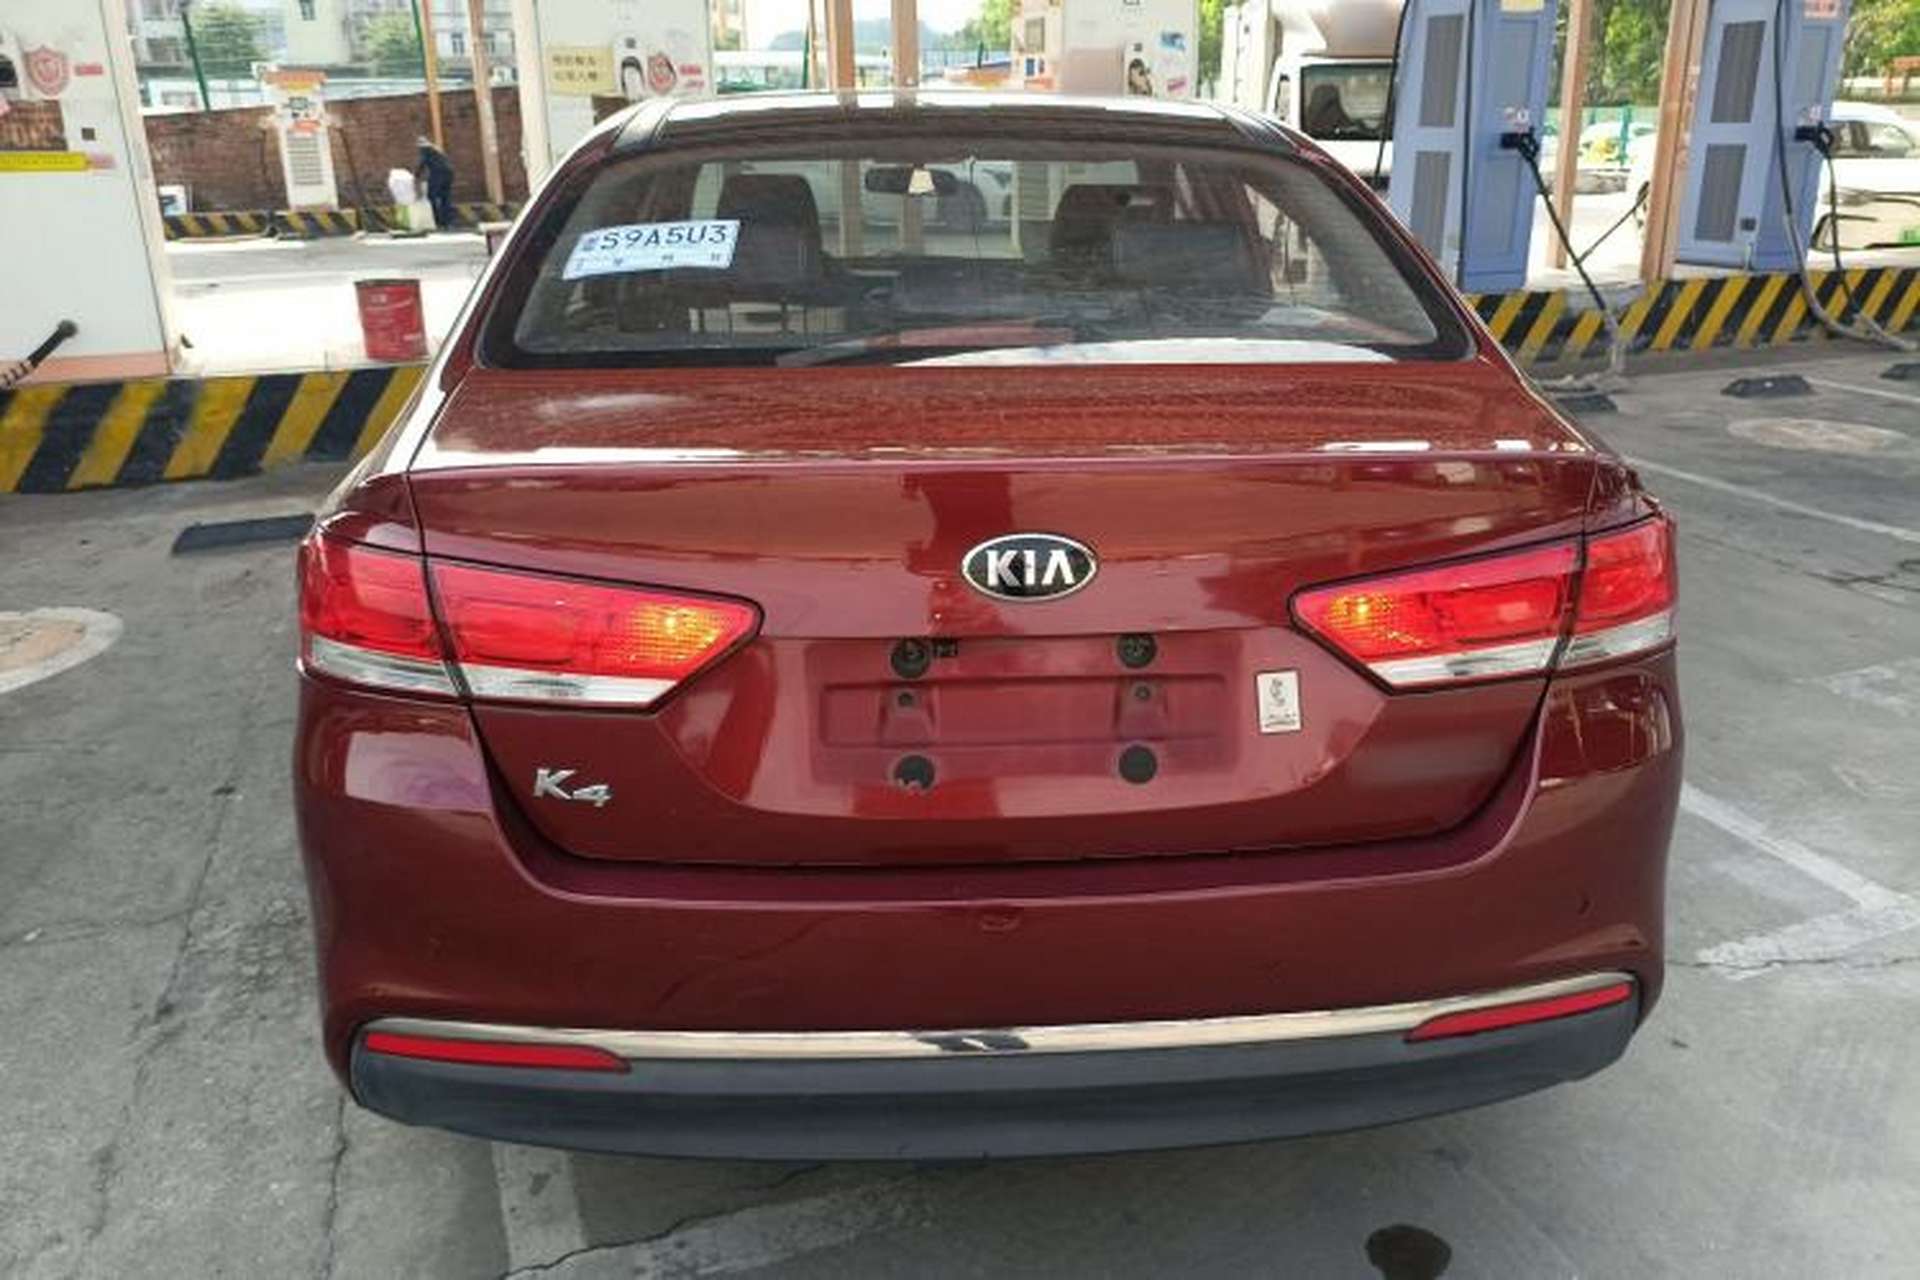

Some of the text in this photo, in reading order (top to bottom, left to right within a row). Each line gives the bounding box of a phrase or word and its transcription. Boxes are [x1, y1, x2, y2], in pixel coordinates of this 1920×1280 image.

[582, 224, 727, 251] S9A5U3
[985, 549, 1076, 586] KIA
[533, 768, 611, 807] K4
